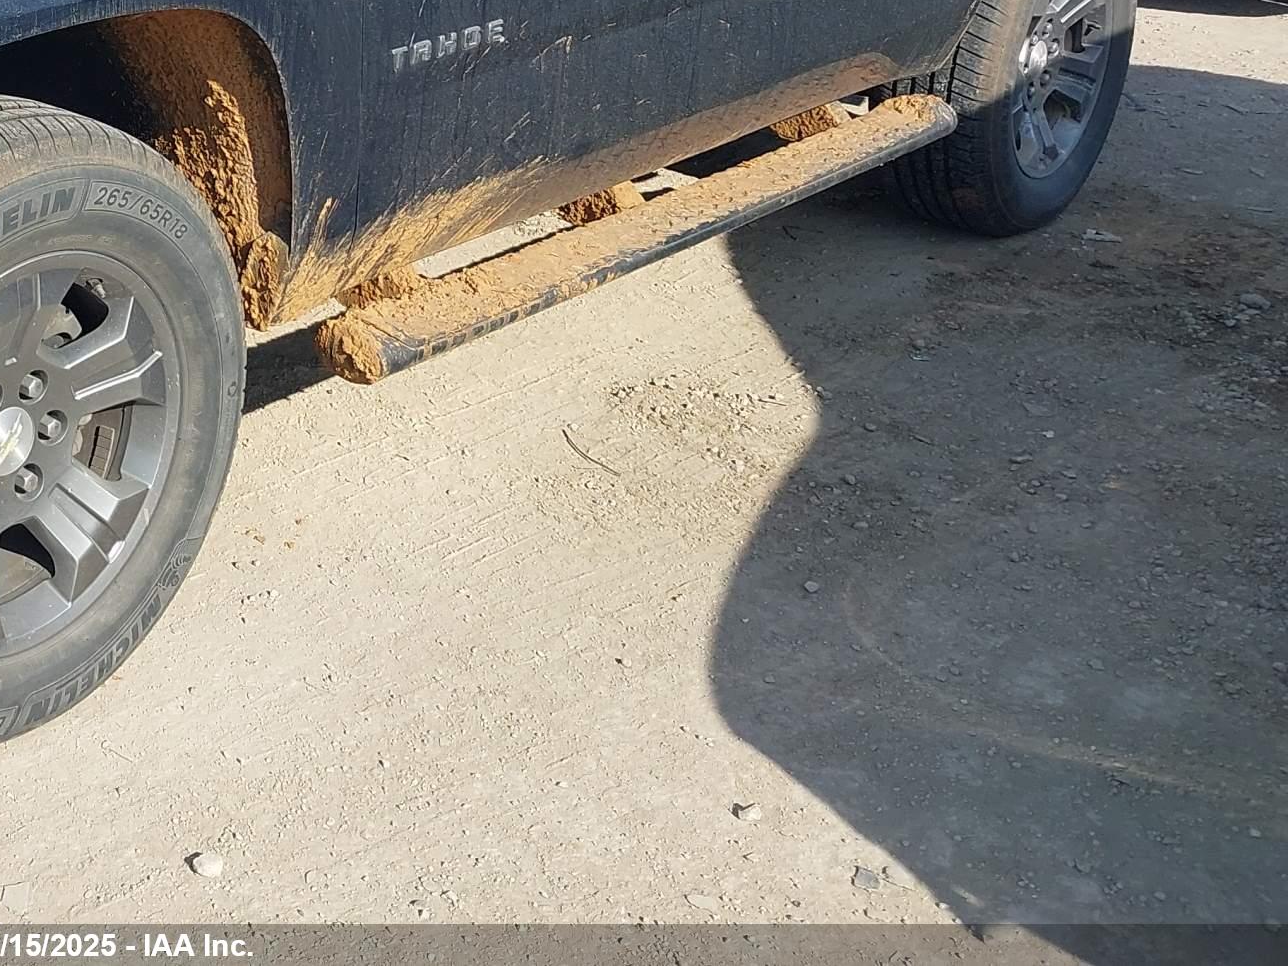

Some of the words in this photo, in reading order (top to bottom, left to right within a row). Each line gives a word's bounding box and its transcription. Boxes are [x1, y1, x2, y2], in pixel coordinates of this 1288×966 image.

[391, 18, 505, 74] TAHOE
[93, 186, 189, 240] 265/65R18
[23, 593, 162, 725] MICHELIN
